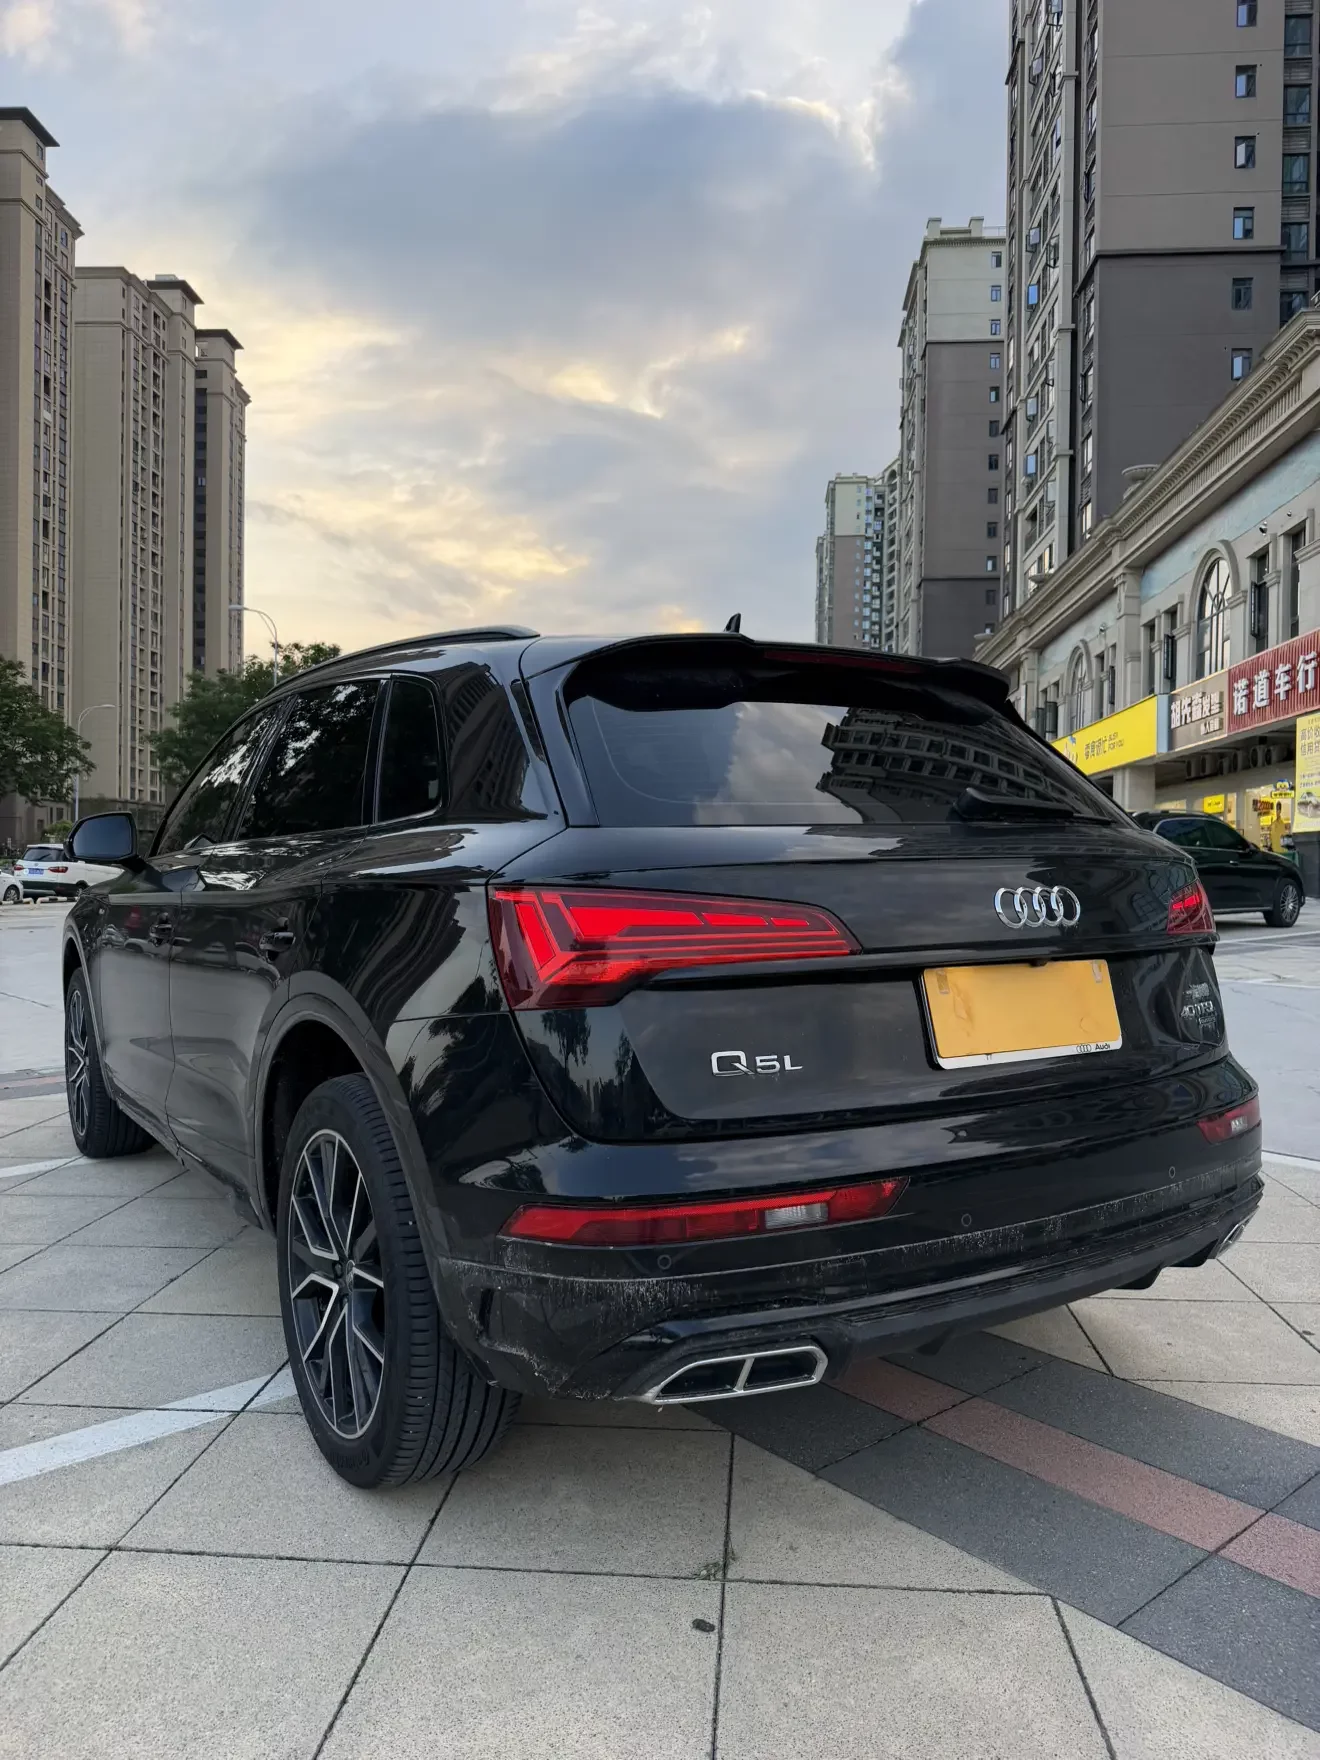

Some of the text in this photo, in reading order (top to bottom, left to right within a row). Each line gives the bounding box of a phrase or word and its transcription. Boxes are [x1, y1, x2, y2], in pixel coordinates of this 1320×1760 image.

[1233, 651, 1318, 715] 诺道车行
[711, 1050, 804, 1077] Q5L
